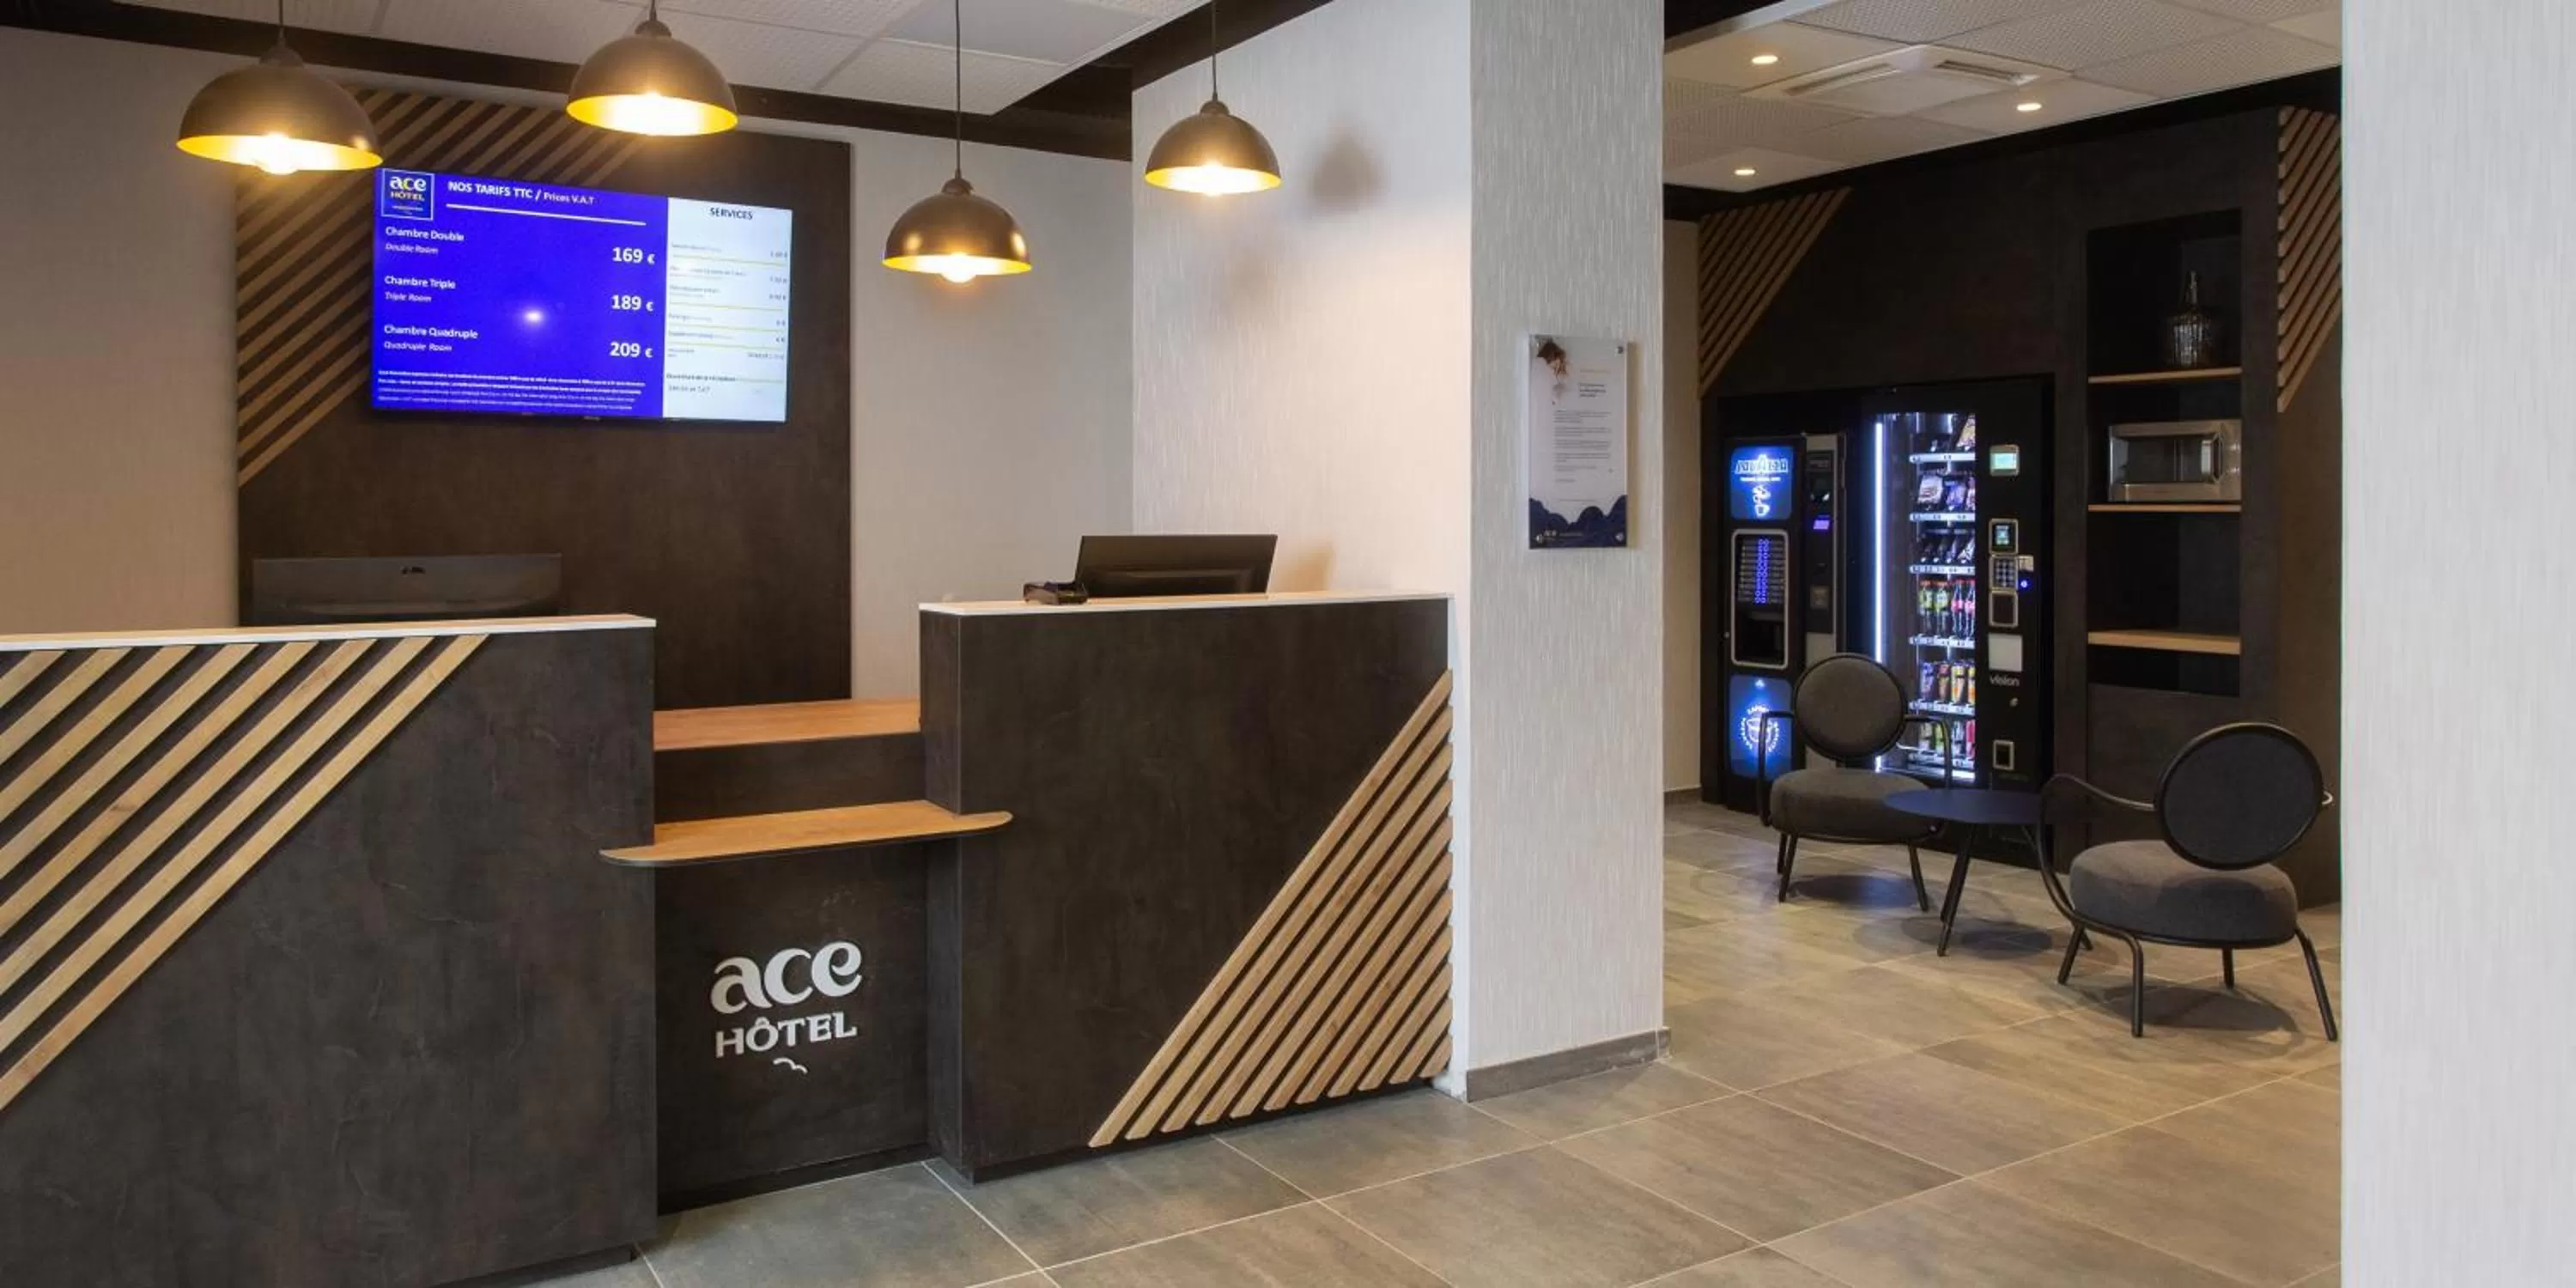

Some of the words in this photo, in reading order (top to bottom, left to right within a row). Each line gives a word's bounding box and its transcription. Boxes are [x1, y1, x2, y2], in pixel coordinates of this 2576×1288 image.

[390, 176, 426, 191] ace
[448, 181, 472, 193] NOS
[475, 184, 510, 197] TARIFS
[513, 187, 533, 199] TTC
[535, 188, 542, 202] /
[544, 191, 569, 203] Prices
[709, 207, 753, 220] SERVICES
[386, 226, 429, 240] Chambre
[430, 229, 465, 242] Double
[386, 243, 413, 253] Double
[415, 245, 439, 255] Room
[612, 246, 643, 264] 169
[647, 253, 655, 264] €
[385, 275, 428, 288] Chambre
[429, 278, 456, 289] Triple
[385, 291, 407, 301] Triple
[409, 293, 432, 302] Room
[611, 295, 641, 311] 189
[645, 301, 654, 312] €
[384, 324, 428, 337] Chambre
[428, 326, 478, 340] Quadruple
[384, 341, 427, 351] Quadruple
[428, 343, 453, 352] Room
[609, 342, 641, 358] 209
[645, 348, 653, 358] €
[710, 941, 862, 1014] ace
[715, 1012, 858, 1058] HÔTEL
